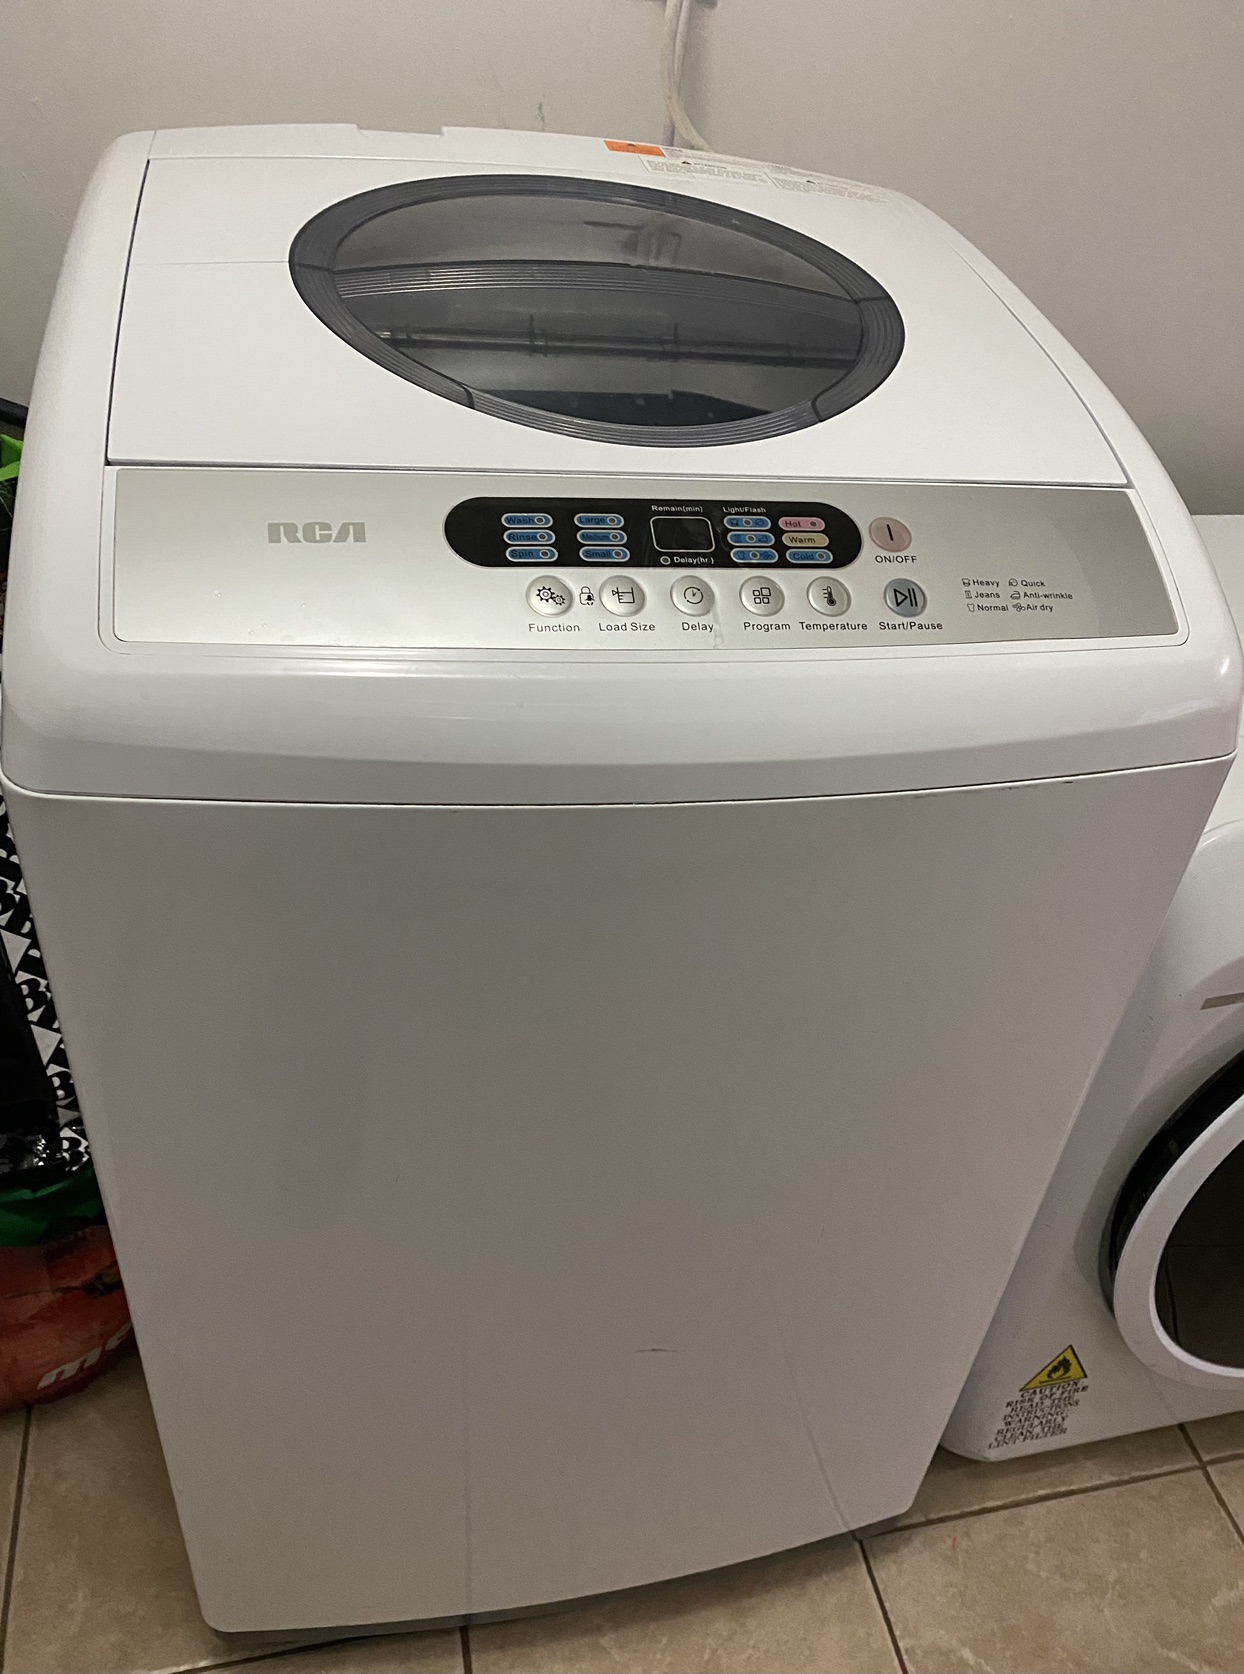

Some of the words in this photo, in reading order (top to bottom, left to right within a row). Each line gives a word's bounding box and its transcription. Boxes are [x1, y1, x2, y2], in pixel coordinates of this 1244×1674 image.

[651, 505, 703, 513] Remain(min)
[723, 506, 767, 514] Light/Flash
[506, 515, 533, 525] Wash
[579, 515, 606, 525] Large
[785, 519, 801, 529] Hot
[267, 521, 367, 544] RCA
[508, 532, 536, 542] Rinse
[581, 533, 610, 542] Medium
[789, 535, 816, 544] Warm
[511, 548, 534, 558] Spin
[585, 550, 611, 559] Small
[793, 551, 814, 561] Cold
[673, 556, 714, 565] Delay(hr.)
[875, 554, 917, 564] ON/OFF
[972, 579, 1000, 588] Heavy
[1020, 579, 1046, 588] Quick
[974, 591, 1000, 599] Jeans
[1023, 591, 1073, 600] Anti-wrinkle
[976, 604, 1009, 612] Normal
[1040, 604, 1053, 612] dry
[528, 622, 580, 632] Function
[598, 622, 628, 632] Load
[630, 622, 656, 631] Size
[681, 622, 714, 633] Delay
[743, 622, 791, 633] Program
[799, 621, 868, 633] Temperature
[879, 621, 943, 632] Start/Pause
